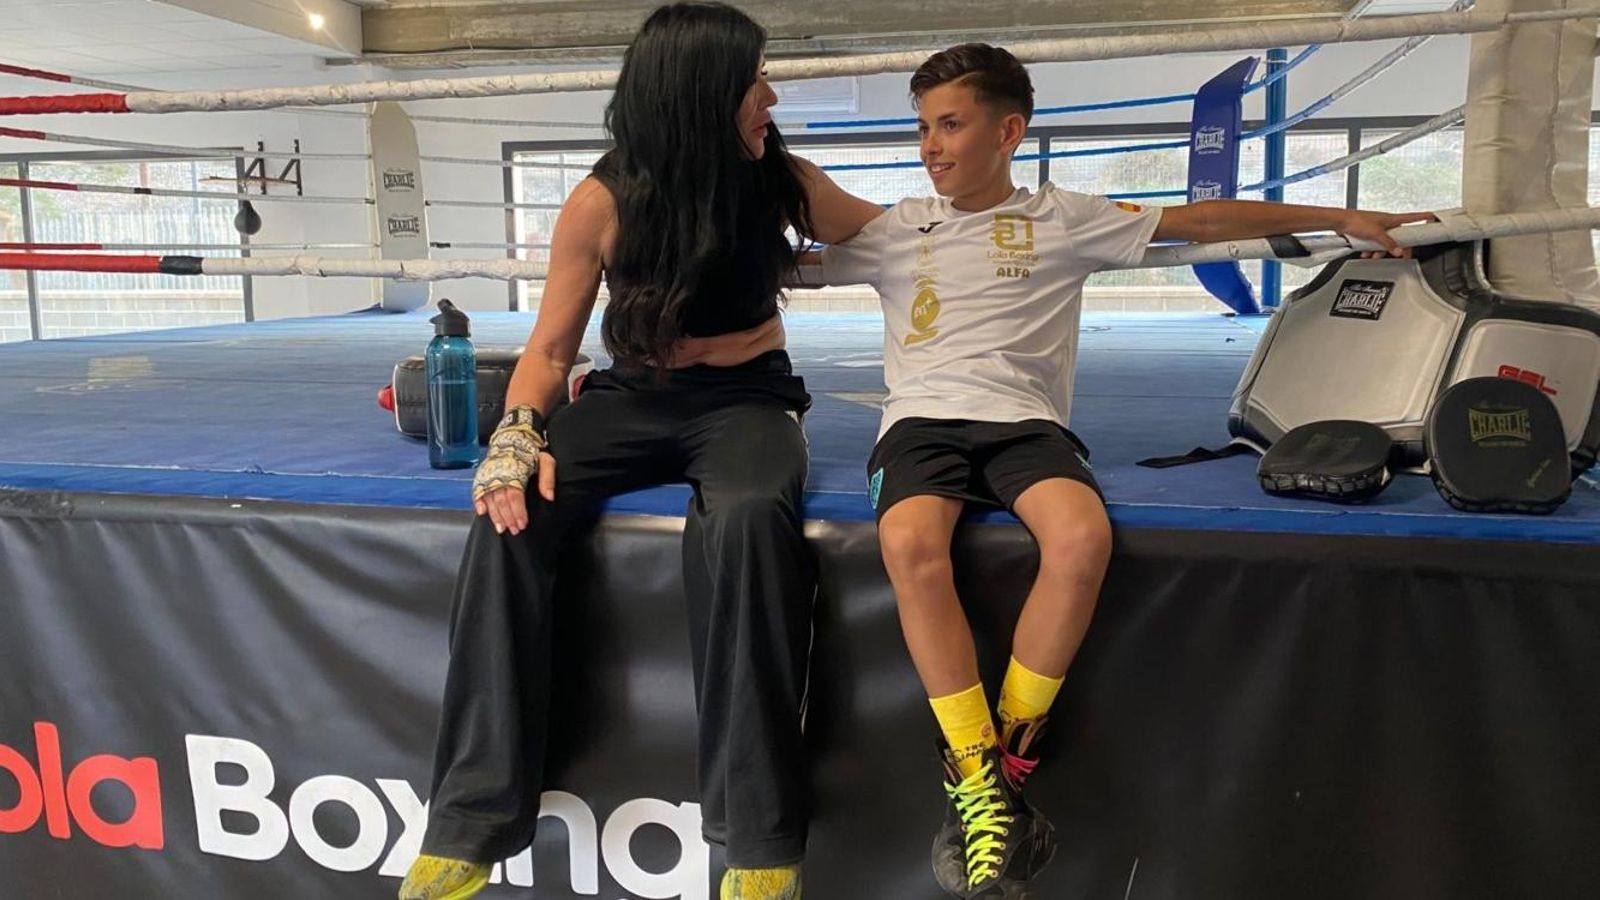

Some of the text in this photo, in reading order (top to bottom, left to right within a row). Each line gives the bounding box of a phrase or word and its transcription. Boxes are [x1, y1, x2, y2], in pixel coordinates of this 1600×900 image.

[997, 267, 1030, 278] ALFA
[1336, 288, 1385, 313] CHARLIE
[1468, 408, 1532, 441] CHARLIE
[185, 734, 709, 900] Boxng
